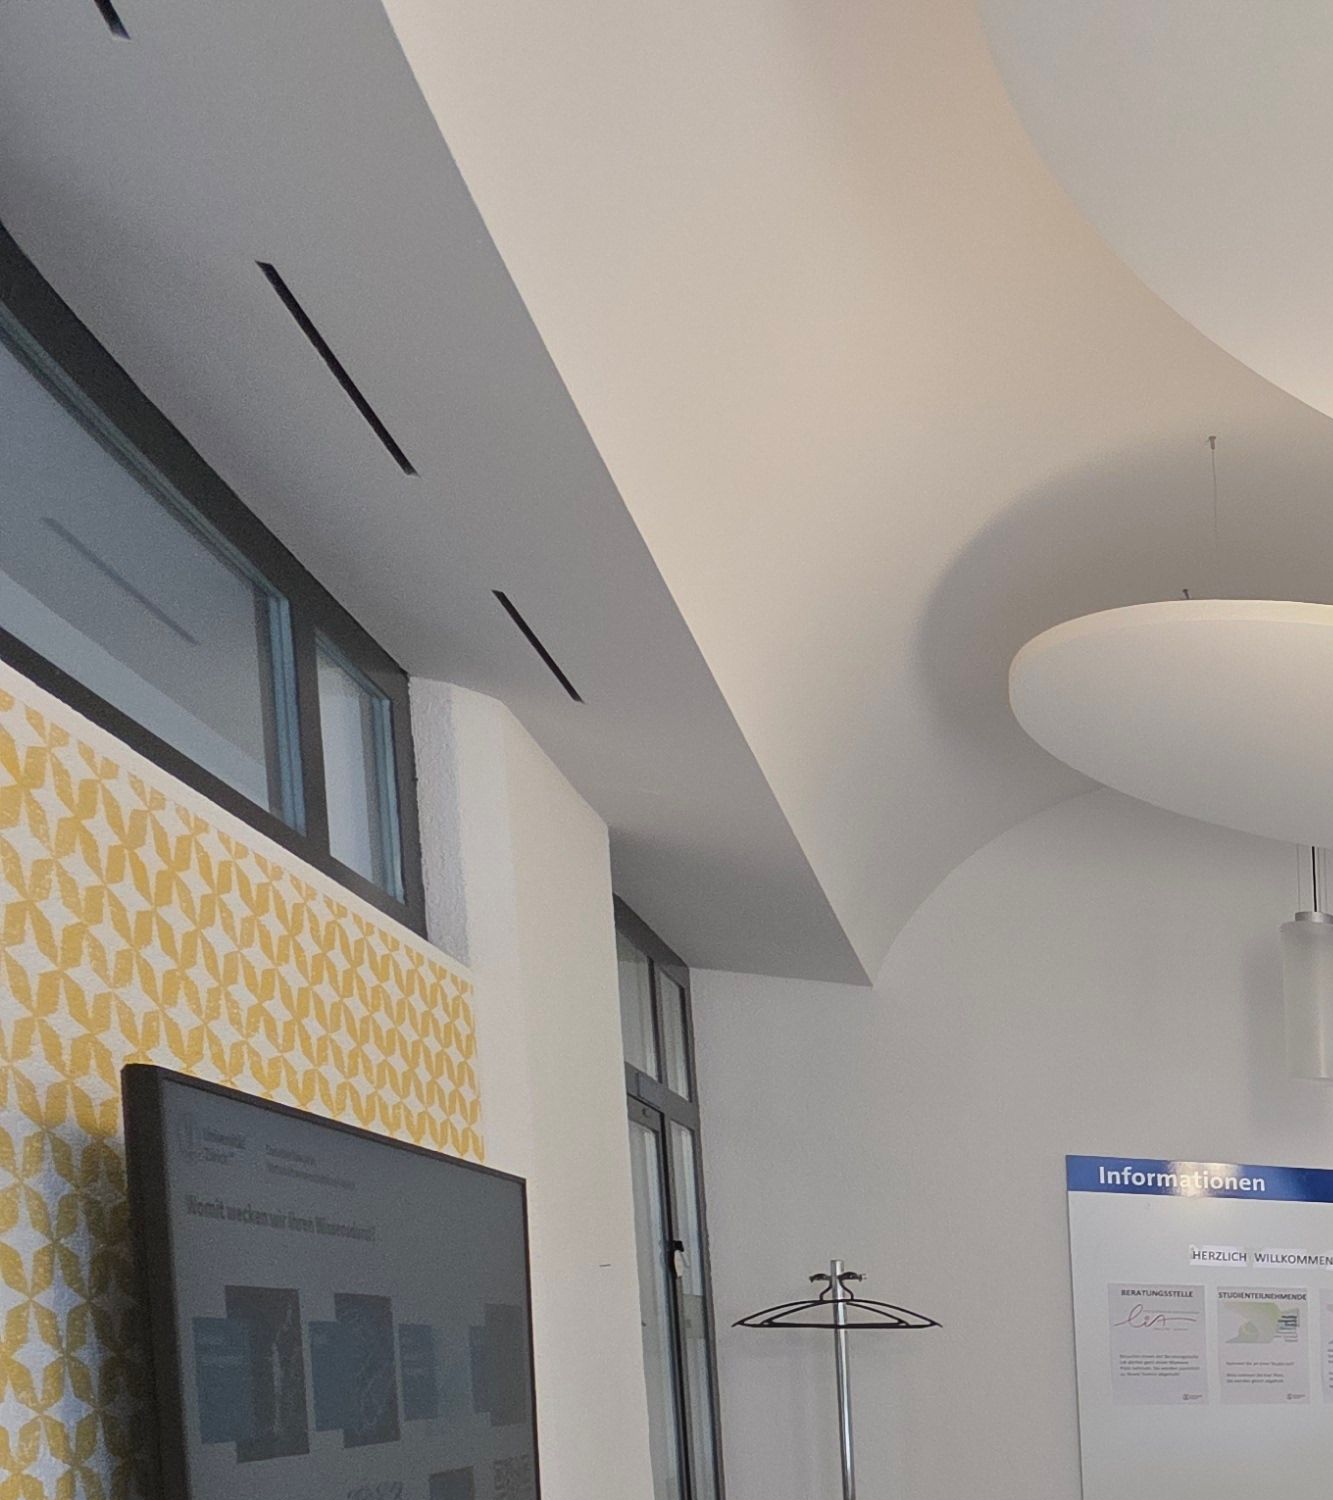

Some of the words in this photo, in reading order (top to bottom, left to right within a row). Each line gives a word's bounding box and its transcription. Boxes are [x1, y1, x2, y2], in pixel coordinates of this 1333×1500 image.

[1099, 1166, 1265, 1192] Informationen
[1192, 1250, 1247, 1262] HERZLICH
[1254, 1253, 1333, 1266] WILLKOMMEN
[1121, 1289, 1194, 1298] BERATUNGSSTELLE
[1218, 1292, 1307, 1301] STUDIENTEILNEHMENDE
